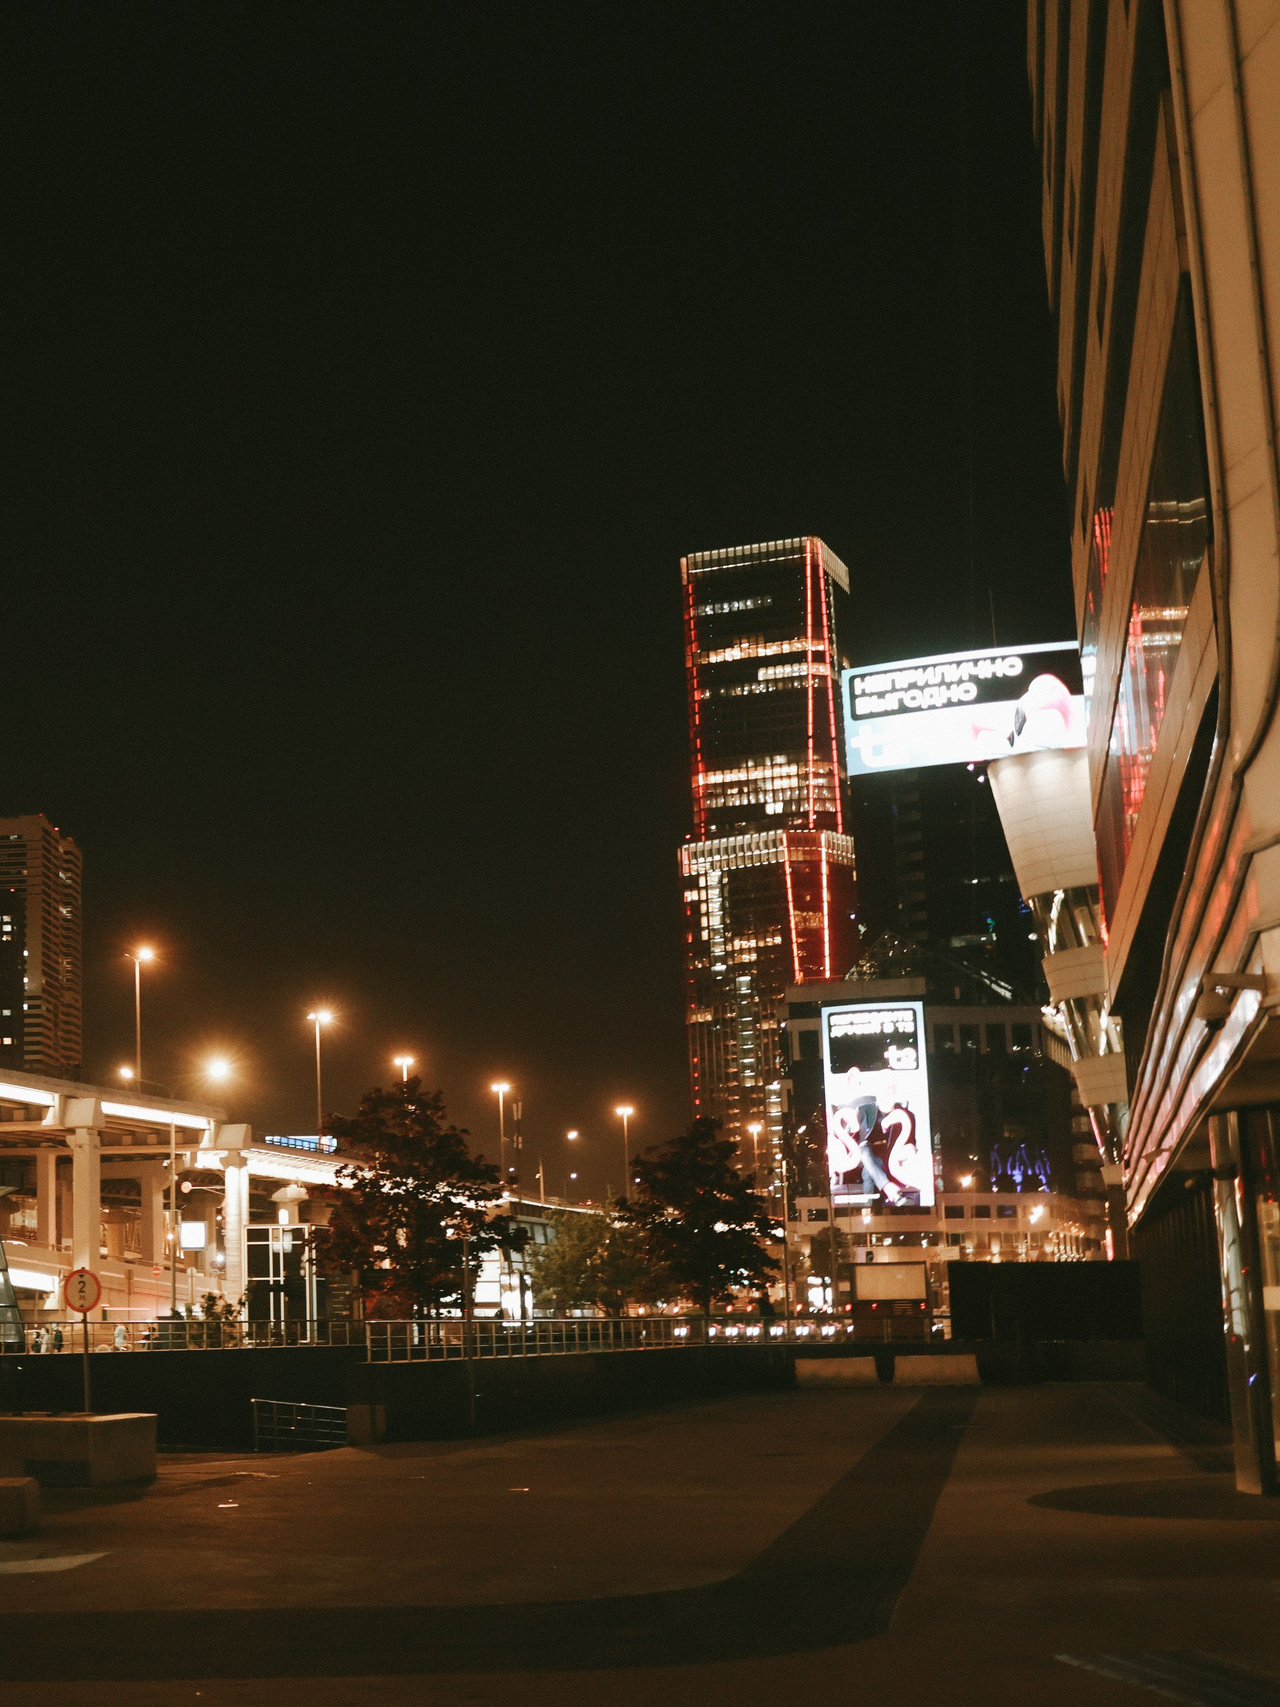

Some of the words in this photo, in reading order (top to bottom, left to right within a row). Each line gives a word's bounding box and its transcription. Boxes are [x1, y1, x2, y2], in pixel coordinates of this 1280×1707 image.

[853, 656, 1023, 695] НЕПРИЛИЧНО
[854, 682, 978, 715] ВЫГОДНО
[78, 1280, 86, 1293] 2
